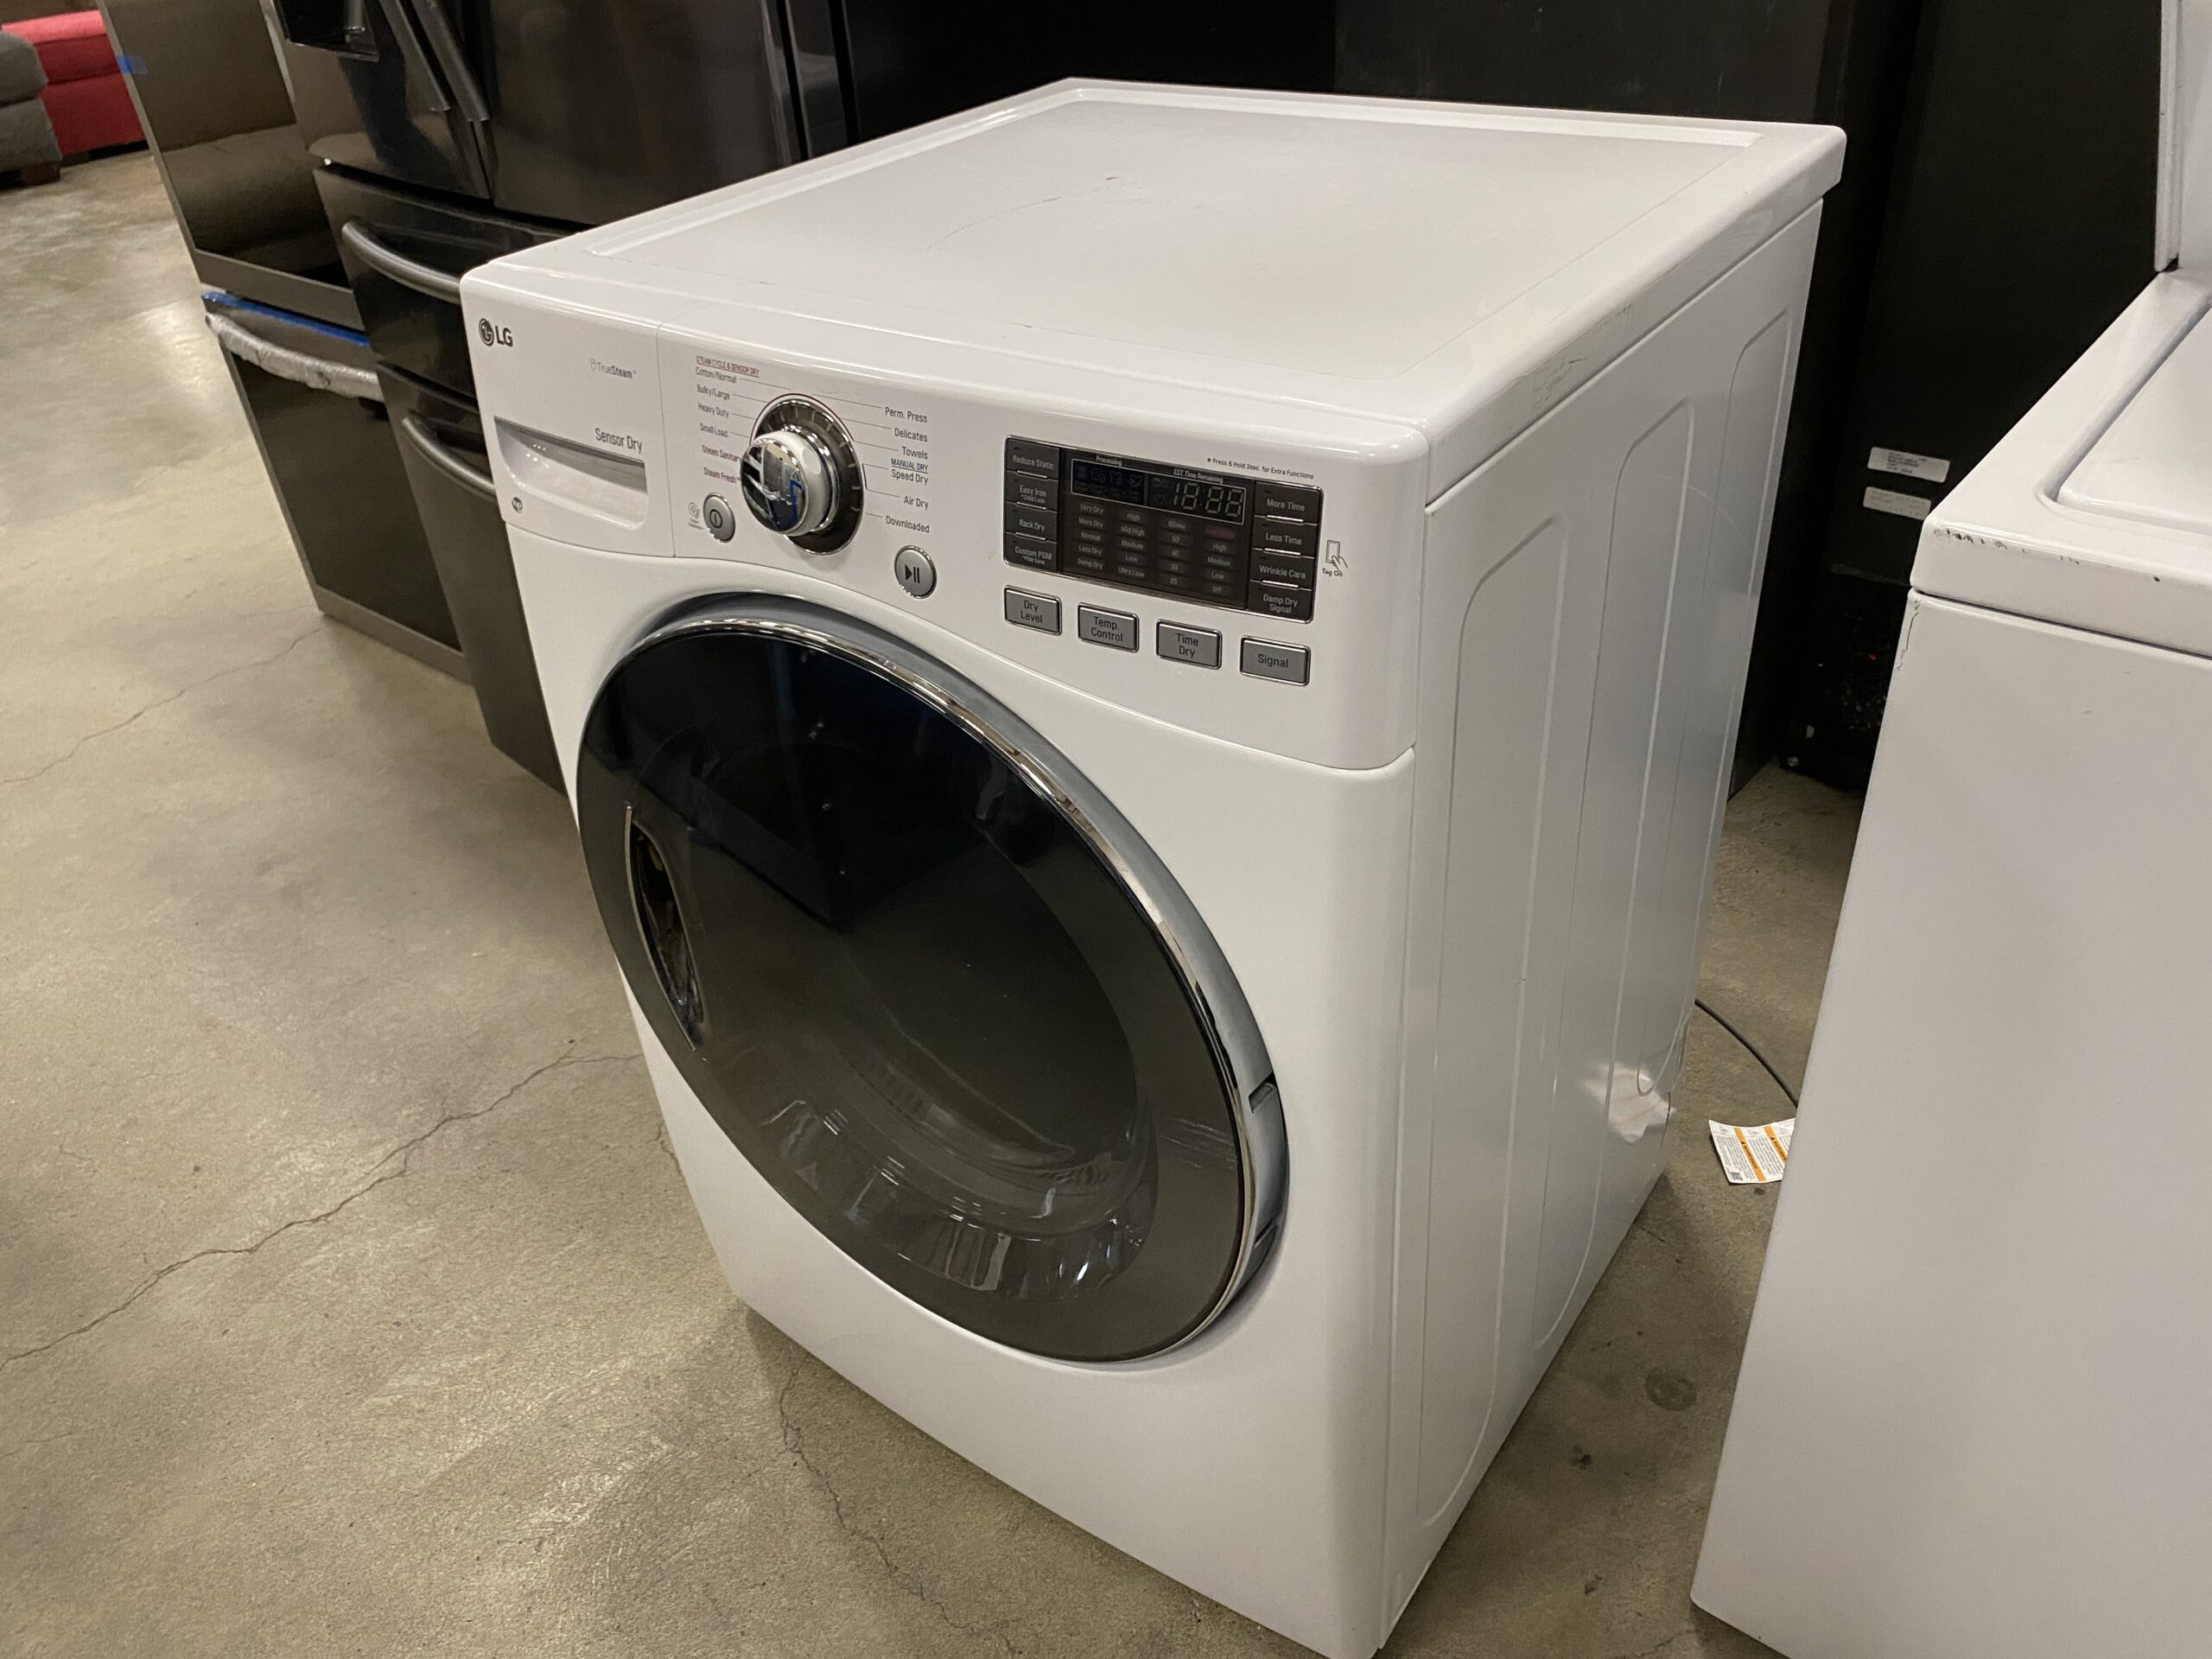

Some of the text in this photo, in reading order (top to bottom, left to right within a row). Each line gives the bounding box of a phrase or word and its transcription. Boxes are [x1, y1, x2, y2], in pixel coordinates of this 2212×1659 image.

[494, 325, 513, 347] LG
[696, 355, 711, 365] STEAM
[712, 359, 727, 368] CYCLE
[731, 363, 749, 373] SENSOR
[750, 367, 760, 376] DRY
[698, 402, 730, 419] Heavy Duty
[885, 407, 927, 423] Perm. Press
[699, 423, 728, 438] Small Load
[894, 427, 928, 442] Delicates
[594, 428, 643, 454] Sensor Dry
[702, 445, 719, 457] Steam
[902, 446, 928, 460] Towels
[891, 458, 928, 473] MANUAL DRY
[1012, 454, 1055, 470] Reduce Static
[1212, 457, 1227, 467] Press
[1233, 461, 1246, 469] Hold
[1262, 465, 1270, 474] for
[1271, 467, 1286, 475] Extra
[1287, 469, 1314, 480] Functions
[703, 467, 721, 480] Steam
[892, 468, 929, 486] Speed Dry
[1019, 485, 1047, 497] Easy Iron
[904, 495, 929, 511] Air Dry
[1266, 499, 1306, 512] More Time
[886, 515, 930, 533] Downloaded
[1019, 518, 1046, 532] Rack Dry
[1265, 532, 1302, 545] Less Time
[1014, 545, 1052, 561] Custom PGM
[1212, 542, 1227, 553] High
[1211, 570, 1224, 580] Low
[1259, 564, 1306, 580] Wrinkle Care
[1322, 568, 1332, 577] Tag
[1024, 600, 1039, 613] Dry
[1262, 594, 1299, 608] Damp Dry
[1268, 603, 1292, 614] Signal
[1020, 610, 1043, 624] Level
[1092, 616, 1119, 632] Temp.
[1090, 627, 1123, 643] Control
[1176, 632, 1199, 647] Time
[1179, 645, 1196, 659] Dry
[1257, 653, 1289, 671] Signal
